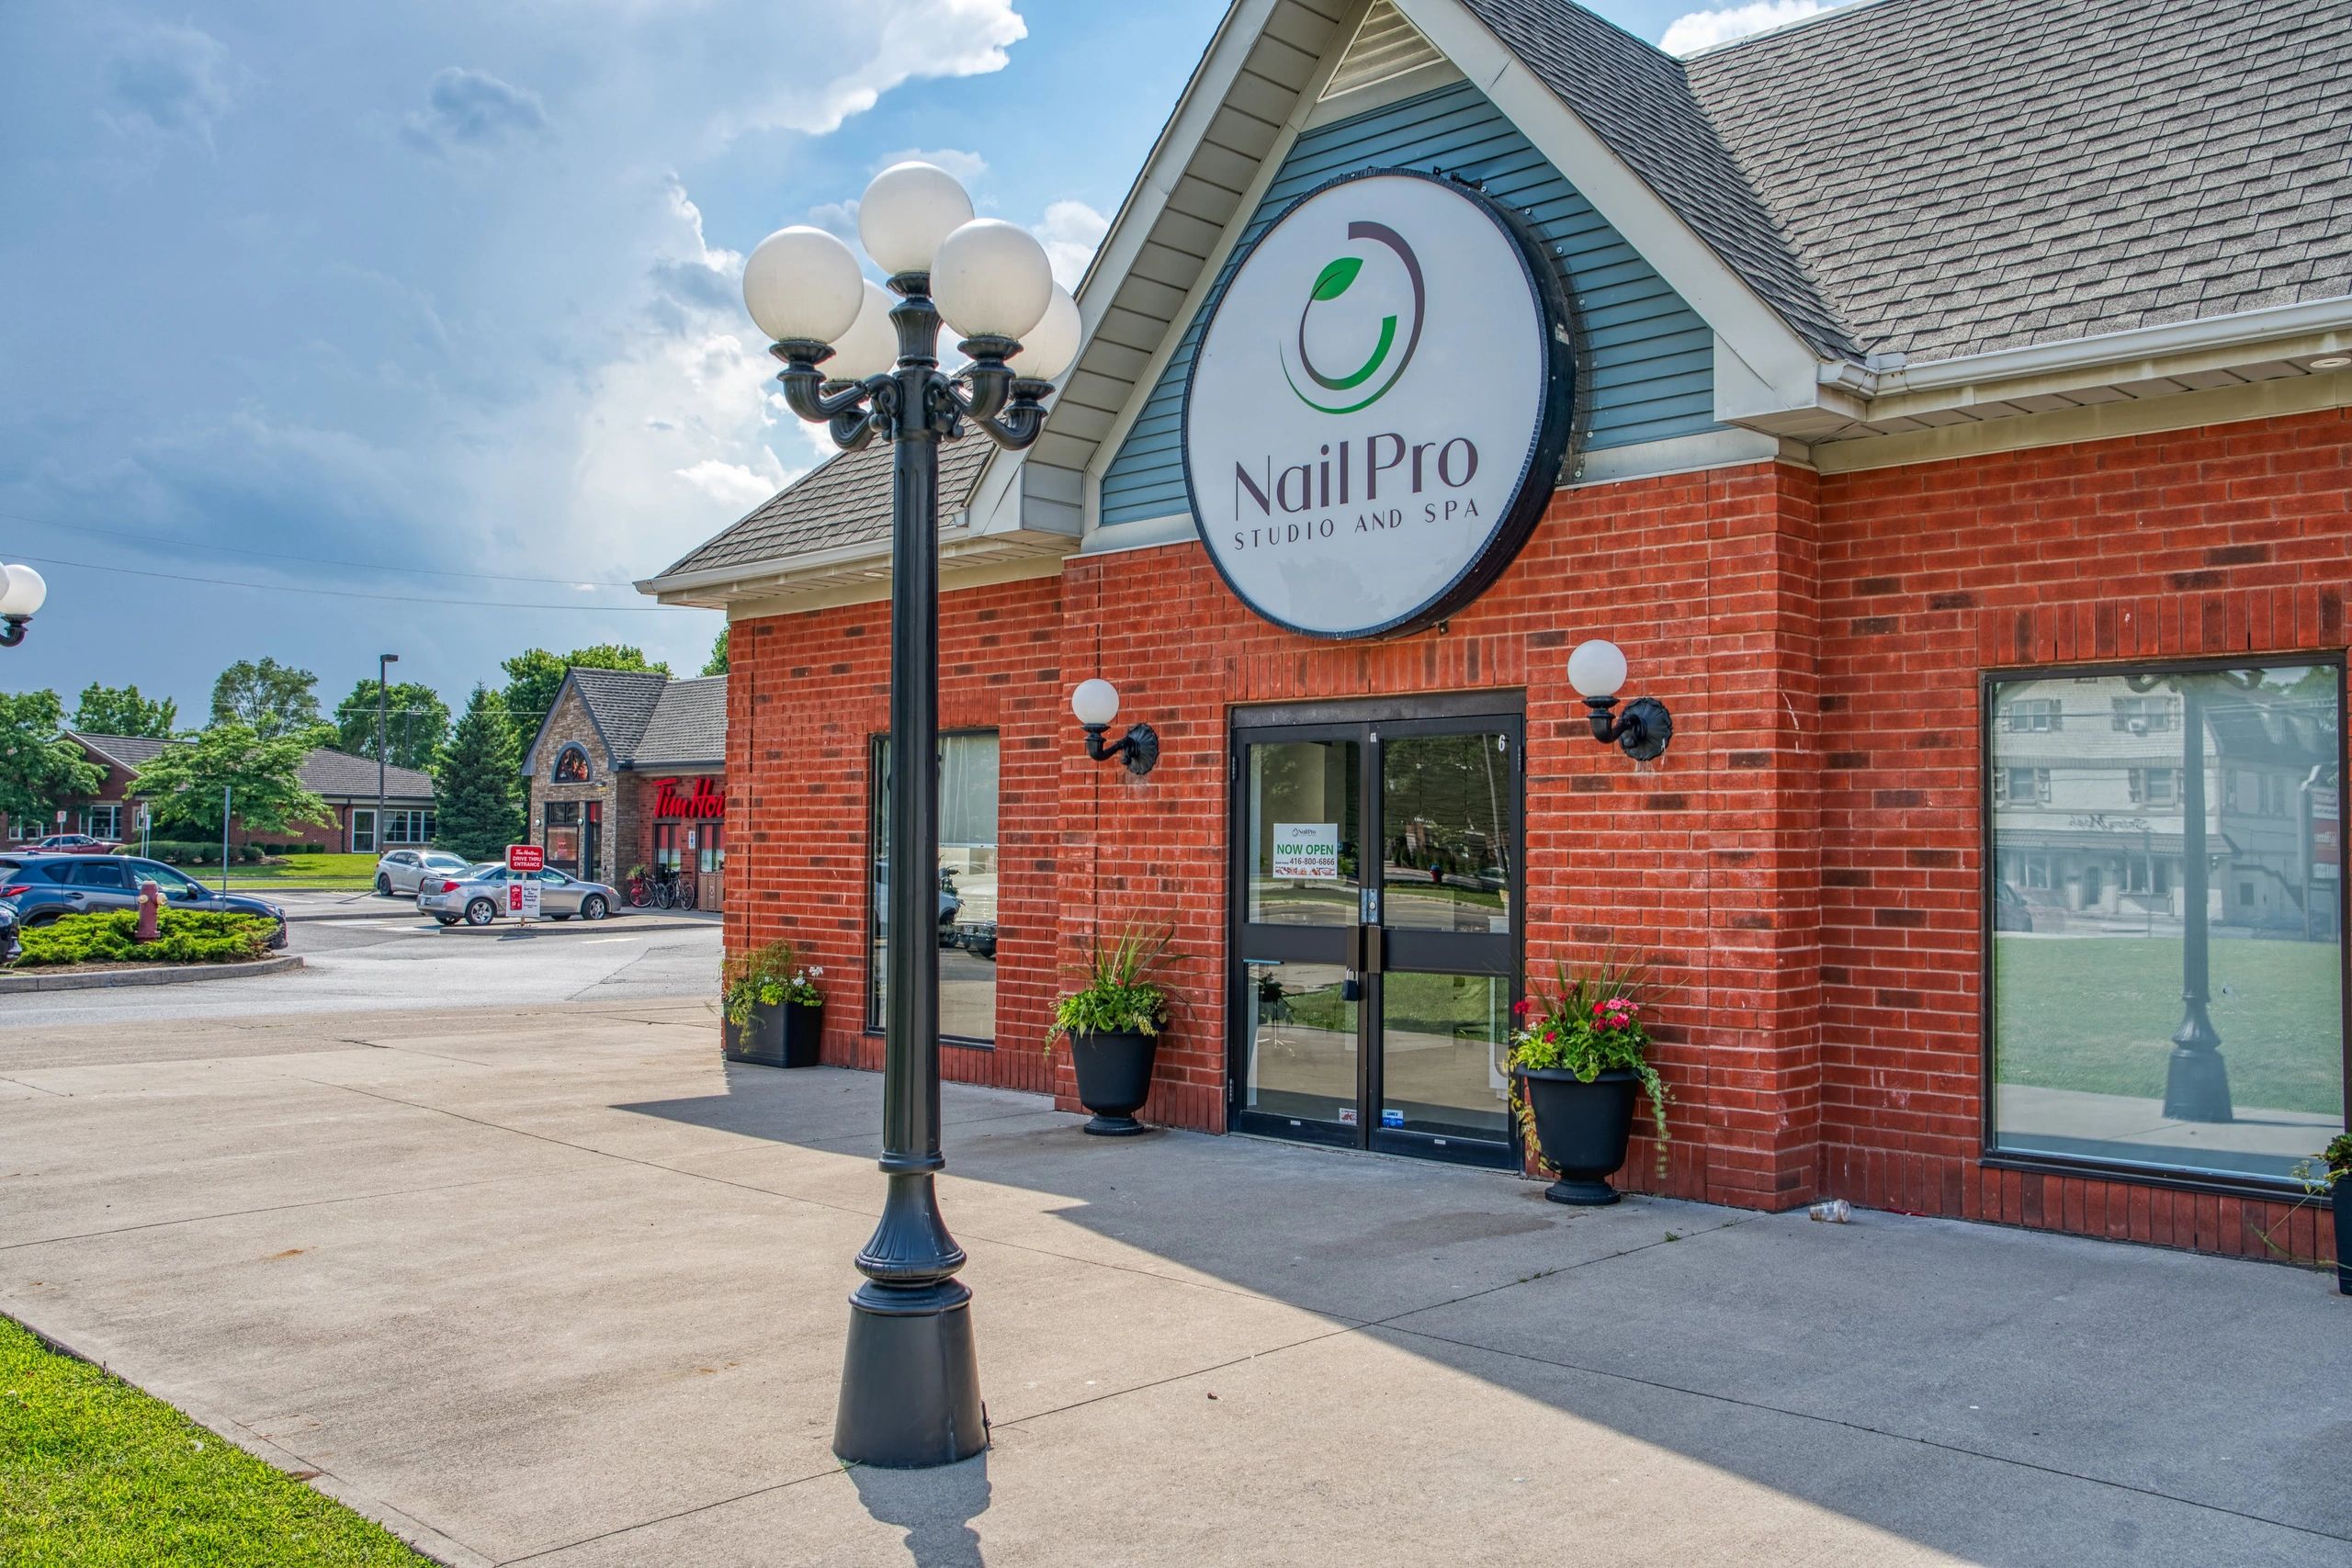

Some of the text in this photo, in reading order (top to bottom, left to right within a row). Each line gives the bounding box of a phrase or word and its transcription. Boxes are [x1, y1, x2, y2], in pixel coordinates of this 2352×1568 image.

[1236, 433, 1478, 522] Nail Pro
[1234, 498, 1479, 550] STUDIO AND SPA
[1498, 734, 1506, 751] 6
[653, 778, 688, 818] Tim
[1277, 844, 1334, 855] NOW OPEN
